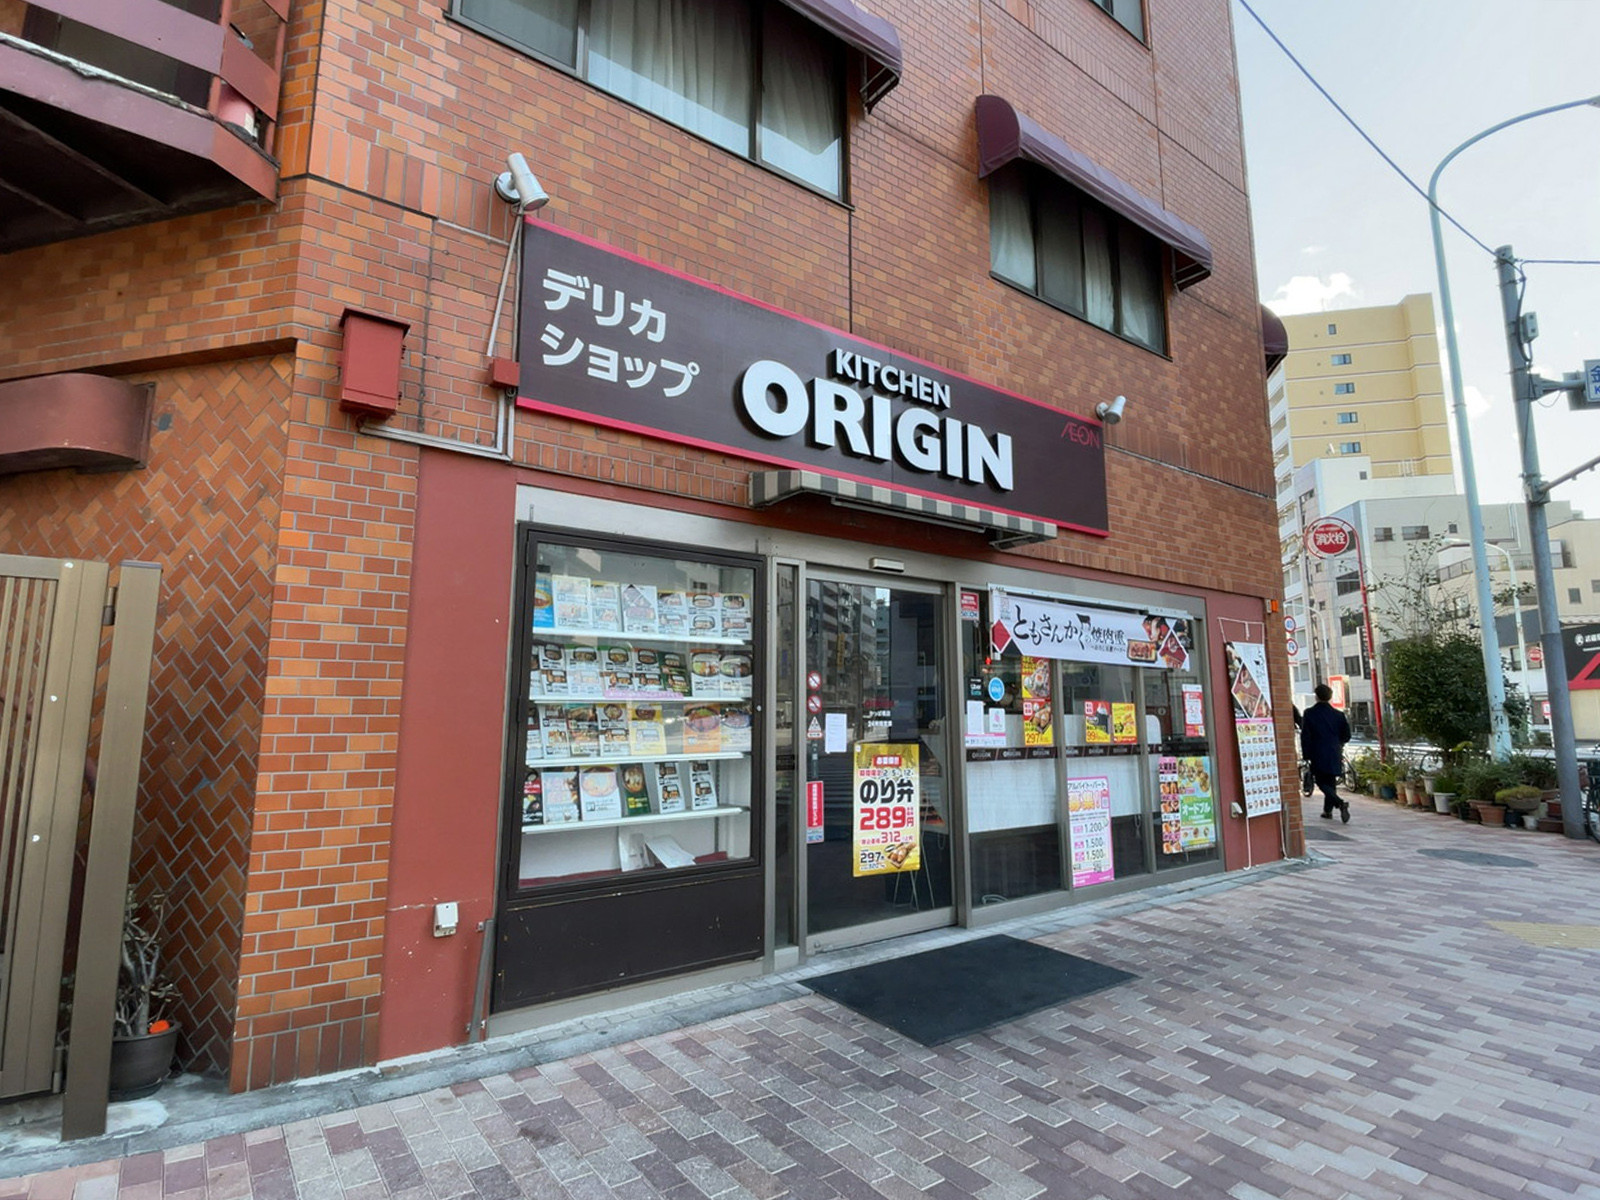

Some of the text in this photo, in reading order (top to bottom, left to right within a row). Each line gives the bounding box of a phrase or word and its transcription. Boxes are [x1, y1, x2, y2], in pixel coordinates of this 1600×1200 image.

[542, 268, 666, 343] デリカ
[540, 322, 700, 398] ショップ
[834, 348, 951, 409] KITCHEN
[740, 358, 1014, 491] ORIGIN
[1316, 532, 1346, 545] 消火栓
[860, 779, 914, 803] のり弁
[860, 806, 906, 830] 289
